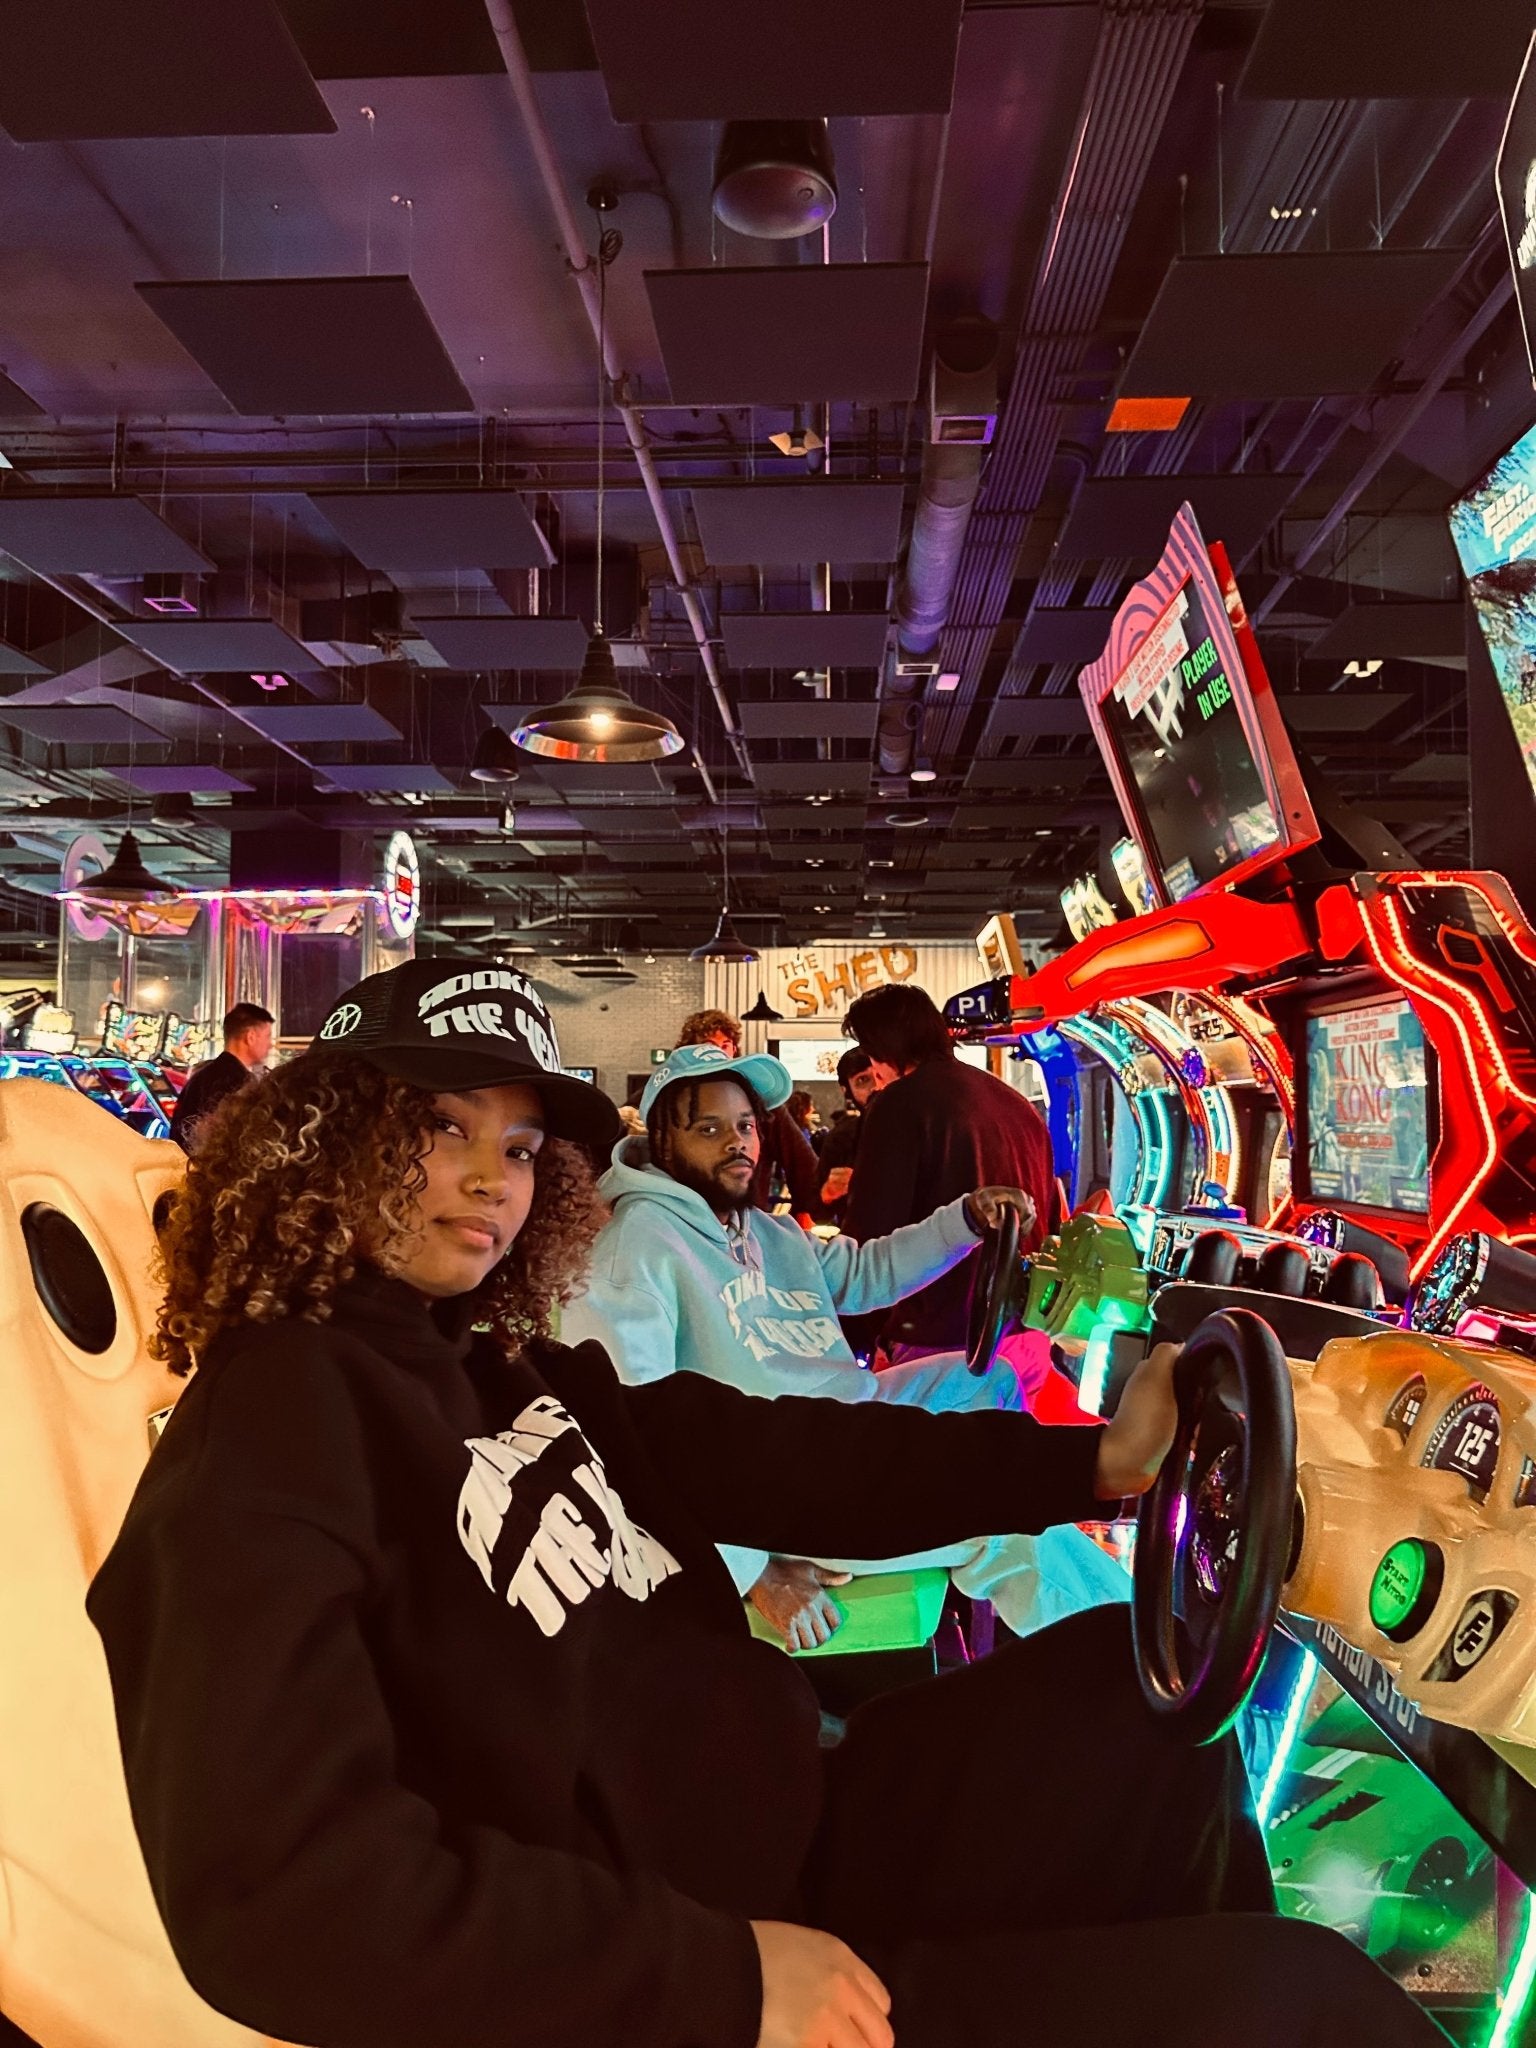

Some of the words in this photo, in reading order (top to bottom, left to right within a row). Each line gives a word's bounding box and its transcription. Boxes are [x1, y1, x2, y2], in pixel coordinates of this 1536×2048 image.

[1181, 636, 1218, 689] PLAYER
[1197, 691, 1214, 720] IN
[1207, 673, 1231, 708] USE
[777, 953, 818, 979] THE
[787, 943, 917, 1018] SHED
[423, 1002, 517, 1041] THE
[958, 995, 986, 1015] P1
[766, 1286, 823, 1311] OF
[1454, 1421, 1494, 1465] 125
[507, 1493, 611, 1637] THE
